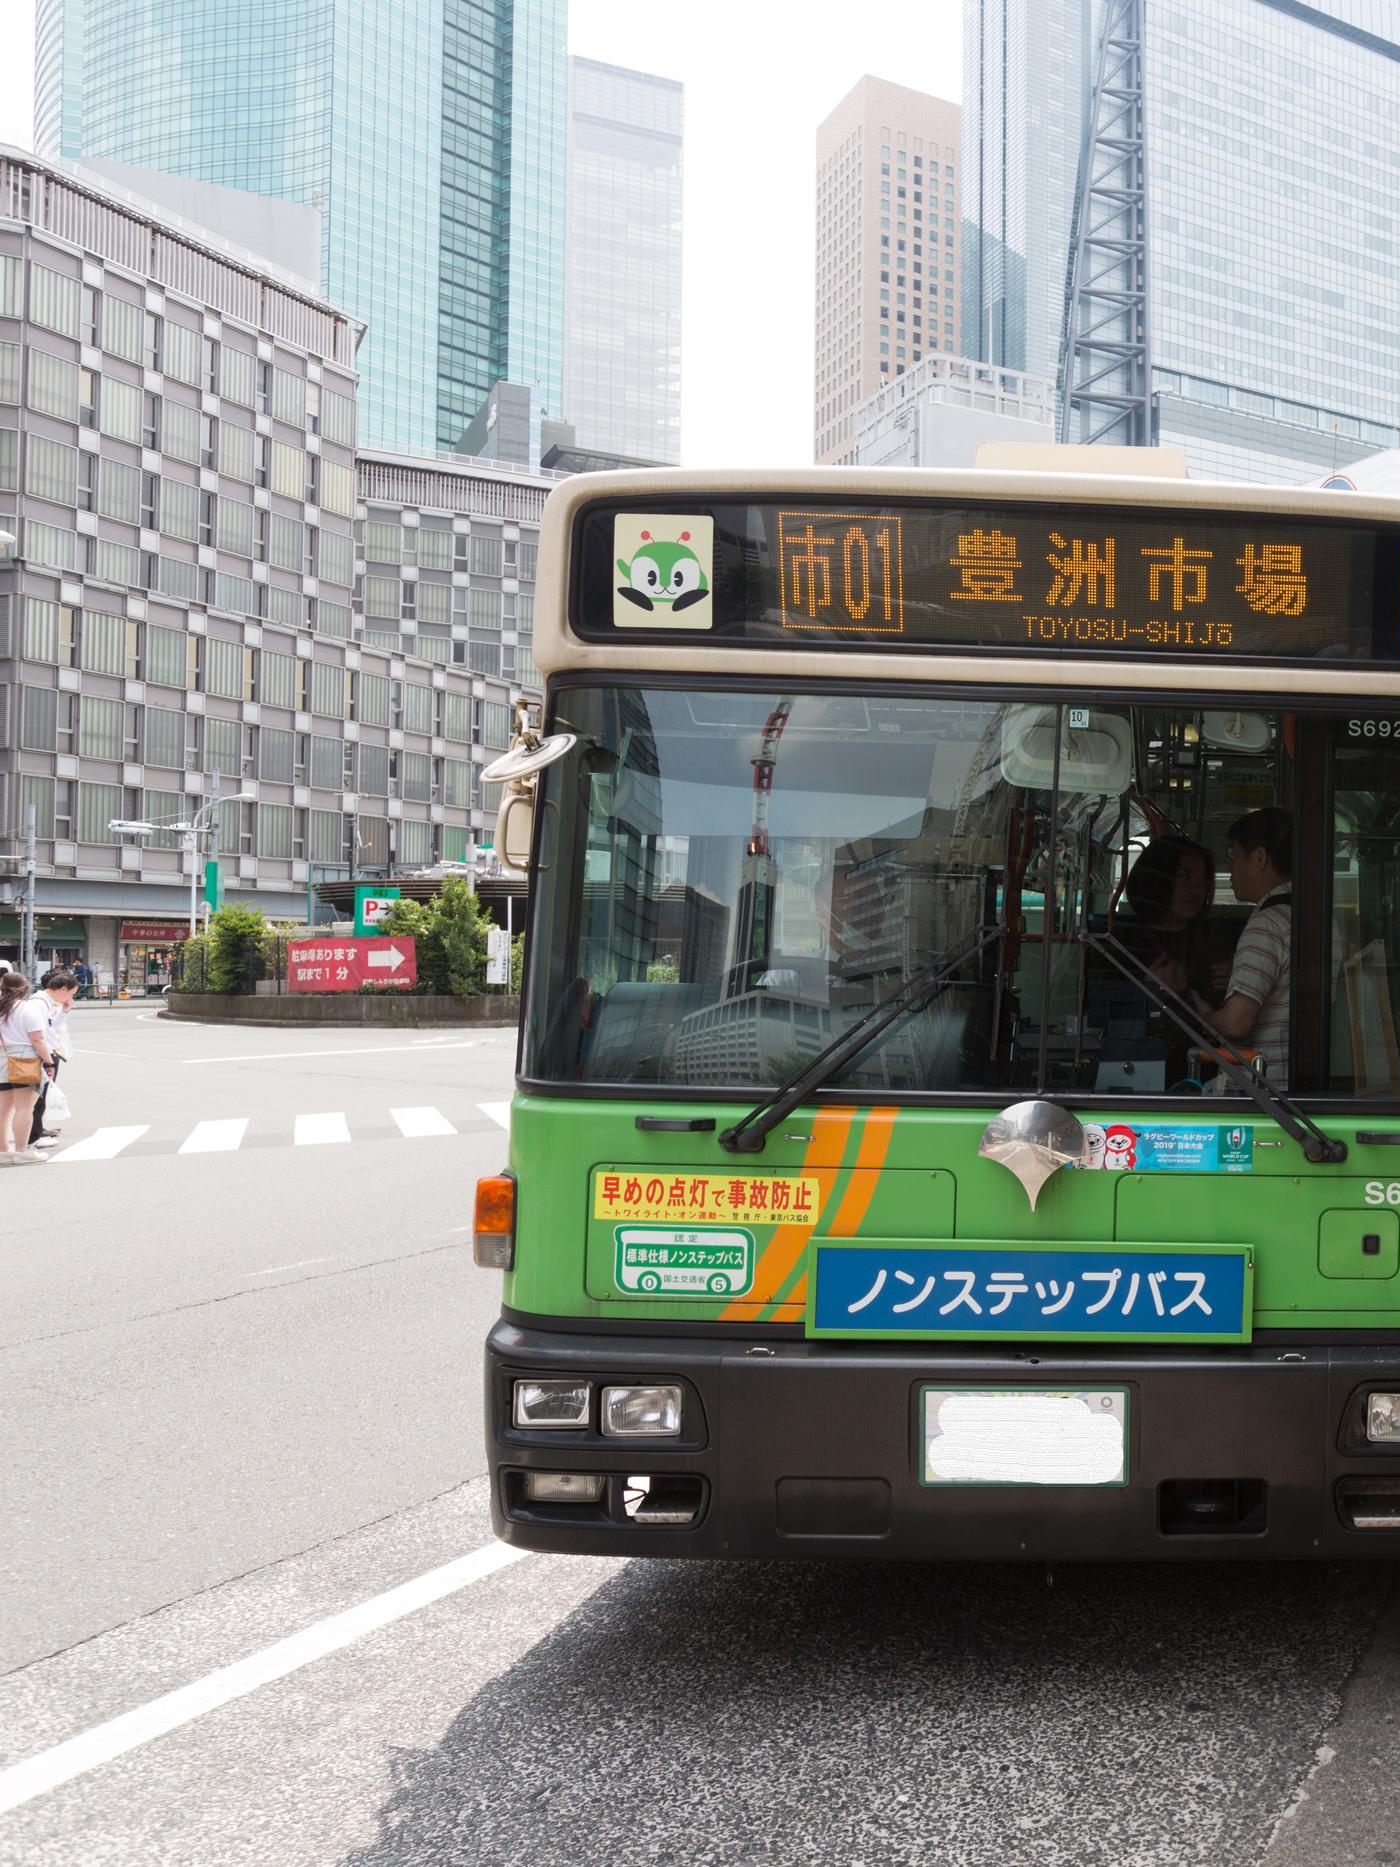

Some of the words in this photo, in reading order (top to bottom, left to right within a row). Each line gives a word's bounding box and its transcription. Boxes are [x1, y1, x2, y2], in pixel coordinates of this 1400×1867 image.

[950, 529, 1306, 615] 豊洲市場
[365, 899, 379, 916] P
[1143, 1132, 1215, 1142] ラグビーワールドカップ
[602, 1176, 812, 1211] 早めの点灯で事故防止
[673, 1234, 698, 1243] 認定
[626, 1248, 743, 1266] 標準仕様ノンステップバス
[663, 1274, 706, 1284] 国土交通省
[715, 1280, 723, 1291] 5
[847, 1268, 1213, 1317] ノンステップバス
